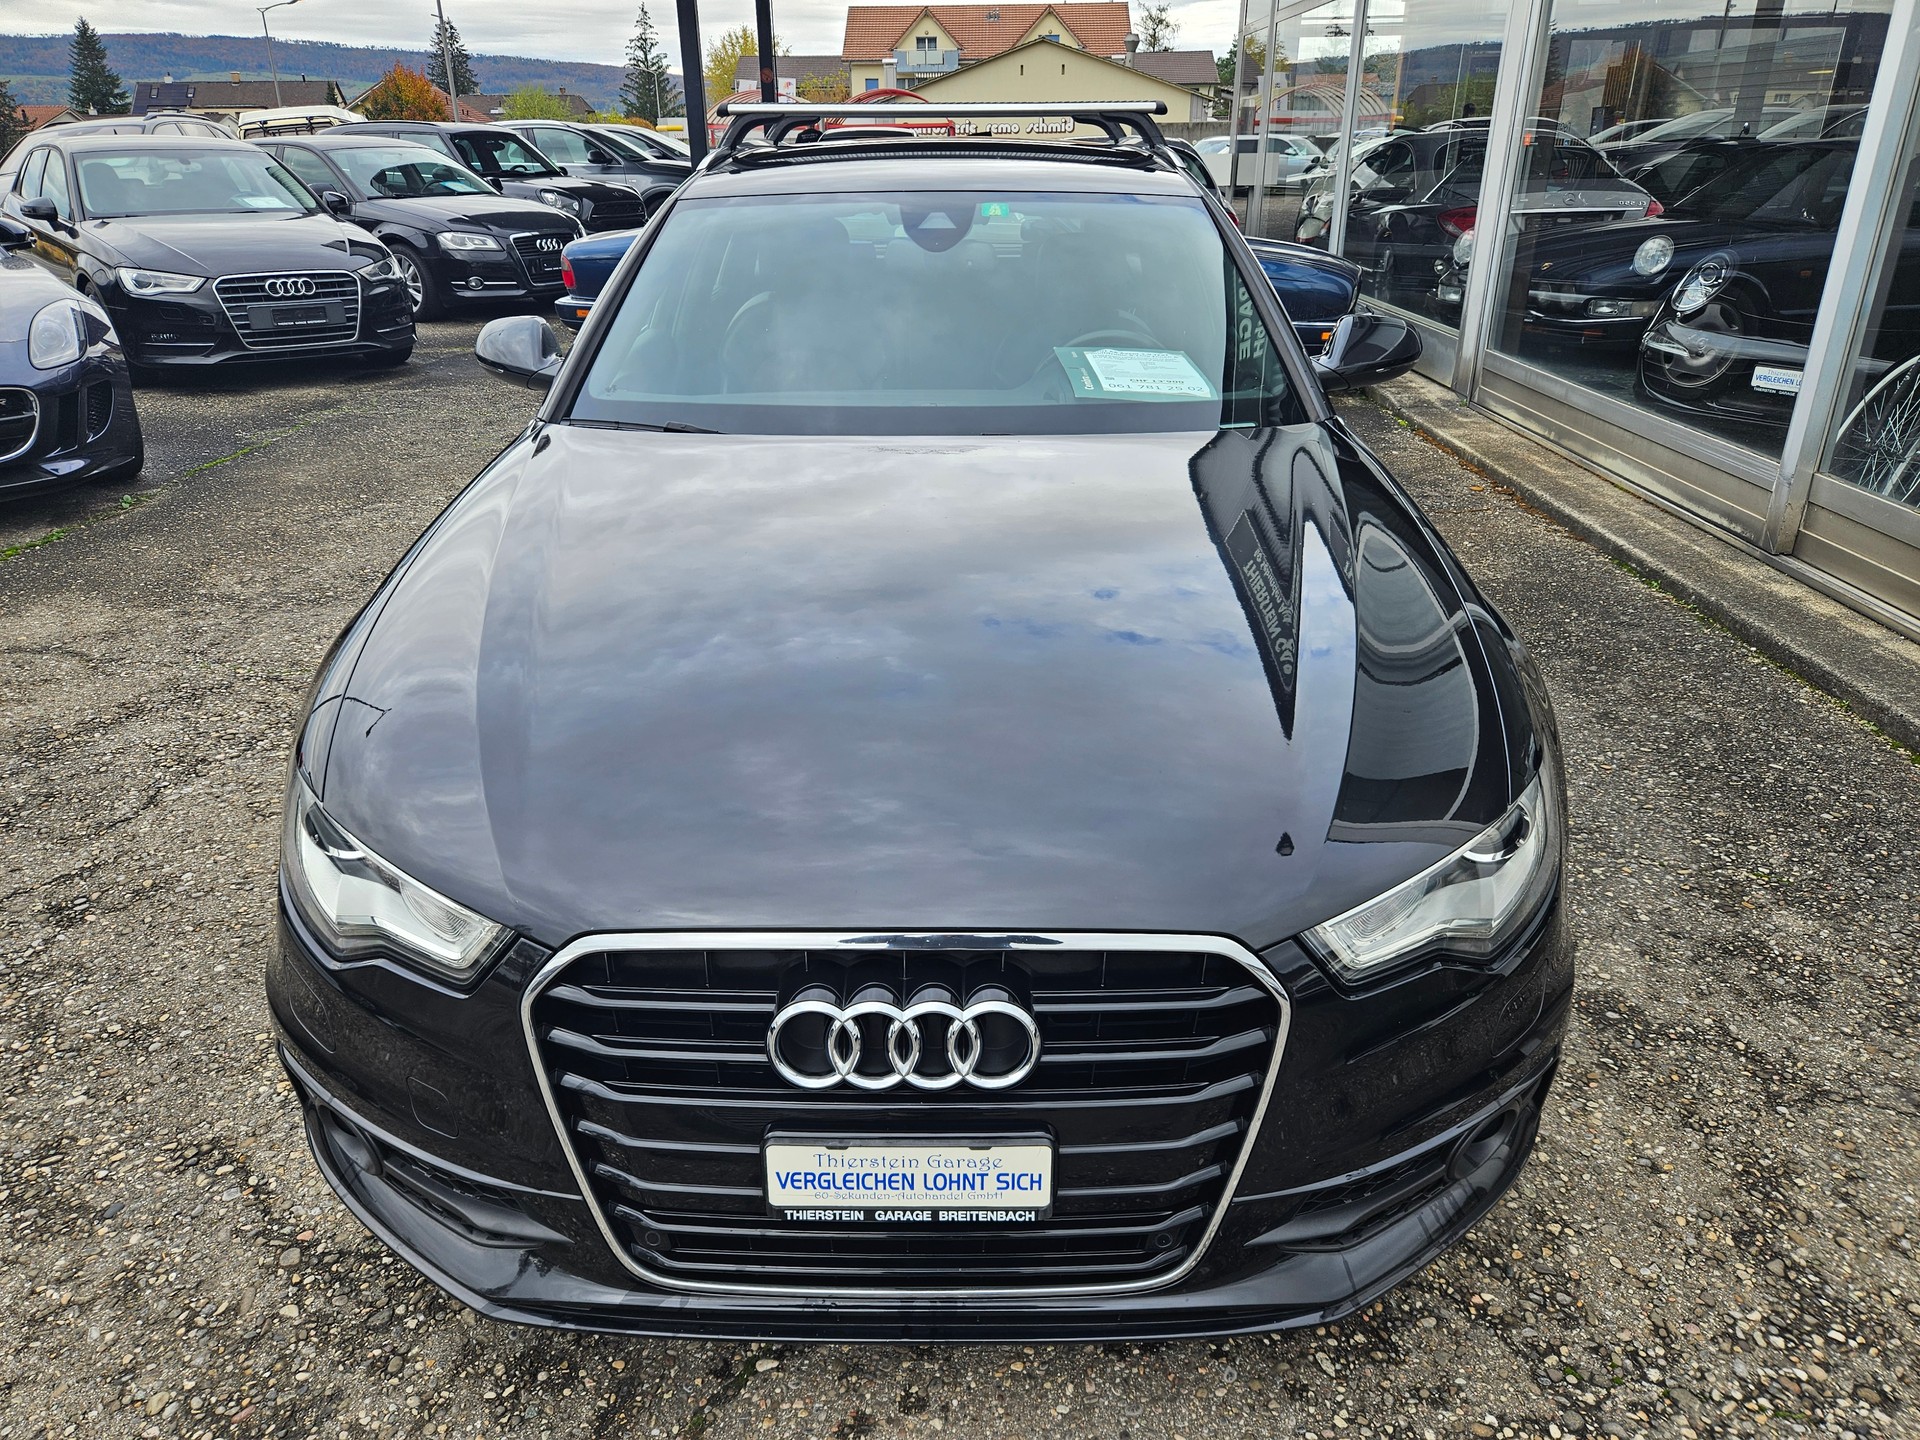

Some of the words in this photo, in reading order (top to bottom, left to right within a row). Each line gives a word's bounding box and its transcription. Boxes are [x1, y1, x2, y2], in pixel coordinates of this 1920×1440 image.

[985, 123, 1020, 135] remo
[1025, 116, 1075, 135] schmid
[1756, 374, 1794, 385] VERGLEICHEN
[813, 1153, 919, 1169] Thierstein
[927, 1154, 1003, 1171] Garage
[776, 1171, 915, 1191] VERGLEICHEN
[923, 1172, 989, 1191] LOHNT
[996, 1173, 1042, 1191] SICH
[784, 1210, 864, 1221] THIERSTEIN
[875, 1211, 932, 1222] GARAGE
[939, 1210, 1036, 1222] BREITENBACH
